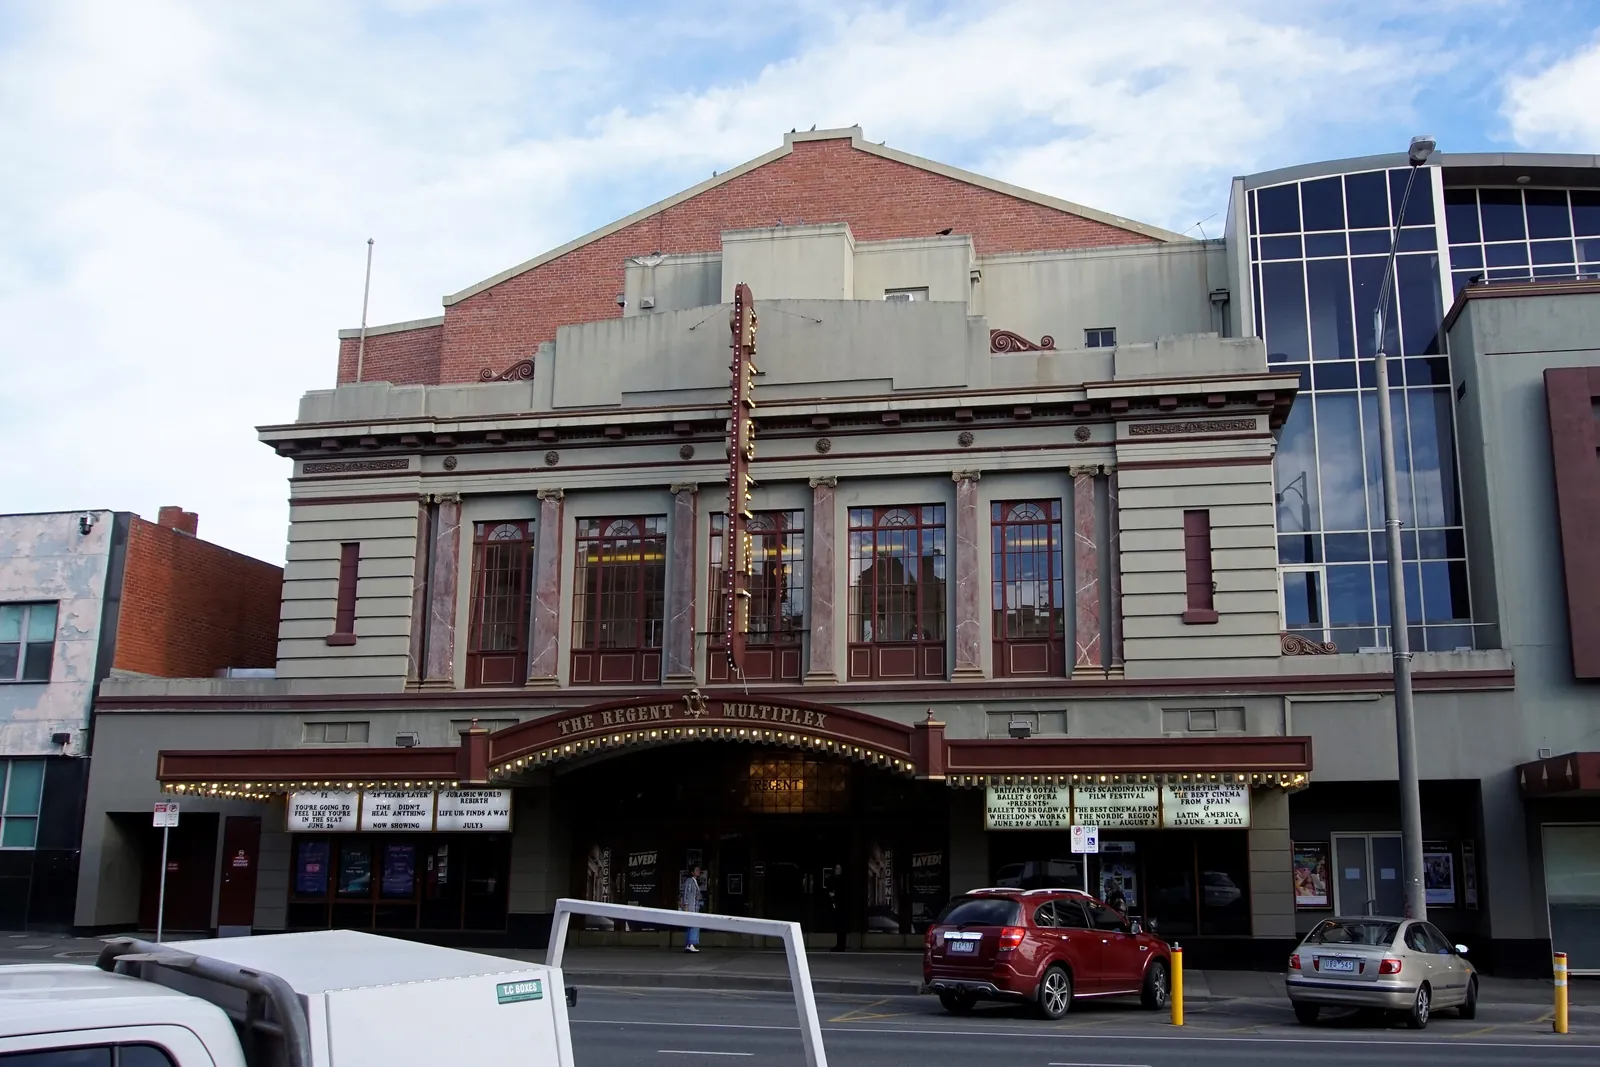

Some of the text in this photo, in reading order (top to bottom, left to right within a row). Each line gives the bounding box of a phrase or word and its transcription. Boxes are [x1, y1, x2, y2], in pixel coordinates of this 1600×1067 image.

[558, 702, 827, 735] THE REGENT MULTIPLEX
[753, 779, 800, 792] REGENT
[628, 854, 658, 866] SAVED!
[912, 854, 942, 868] SAVED!
[602, 850, 610, 903] REGENT
[515, 982, 538, 994] BOXES
